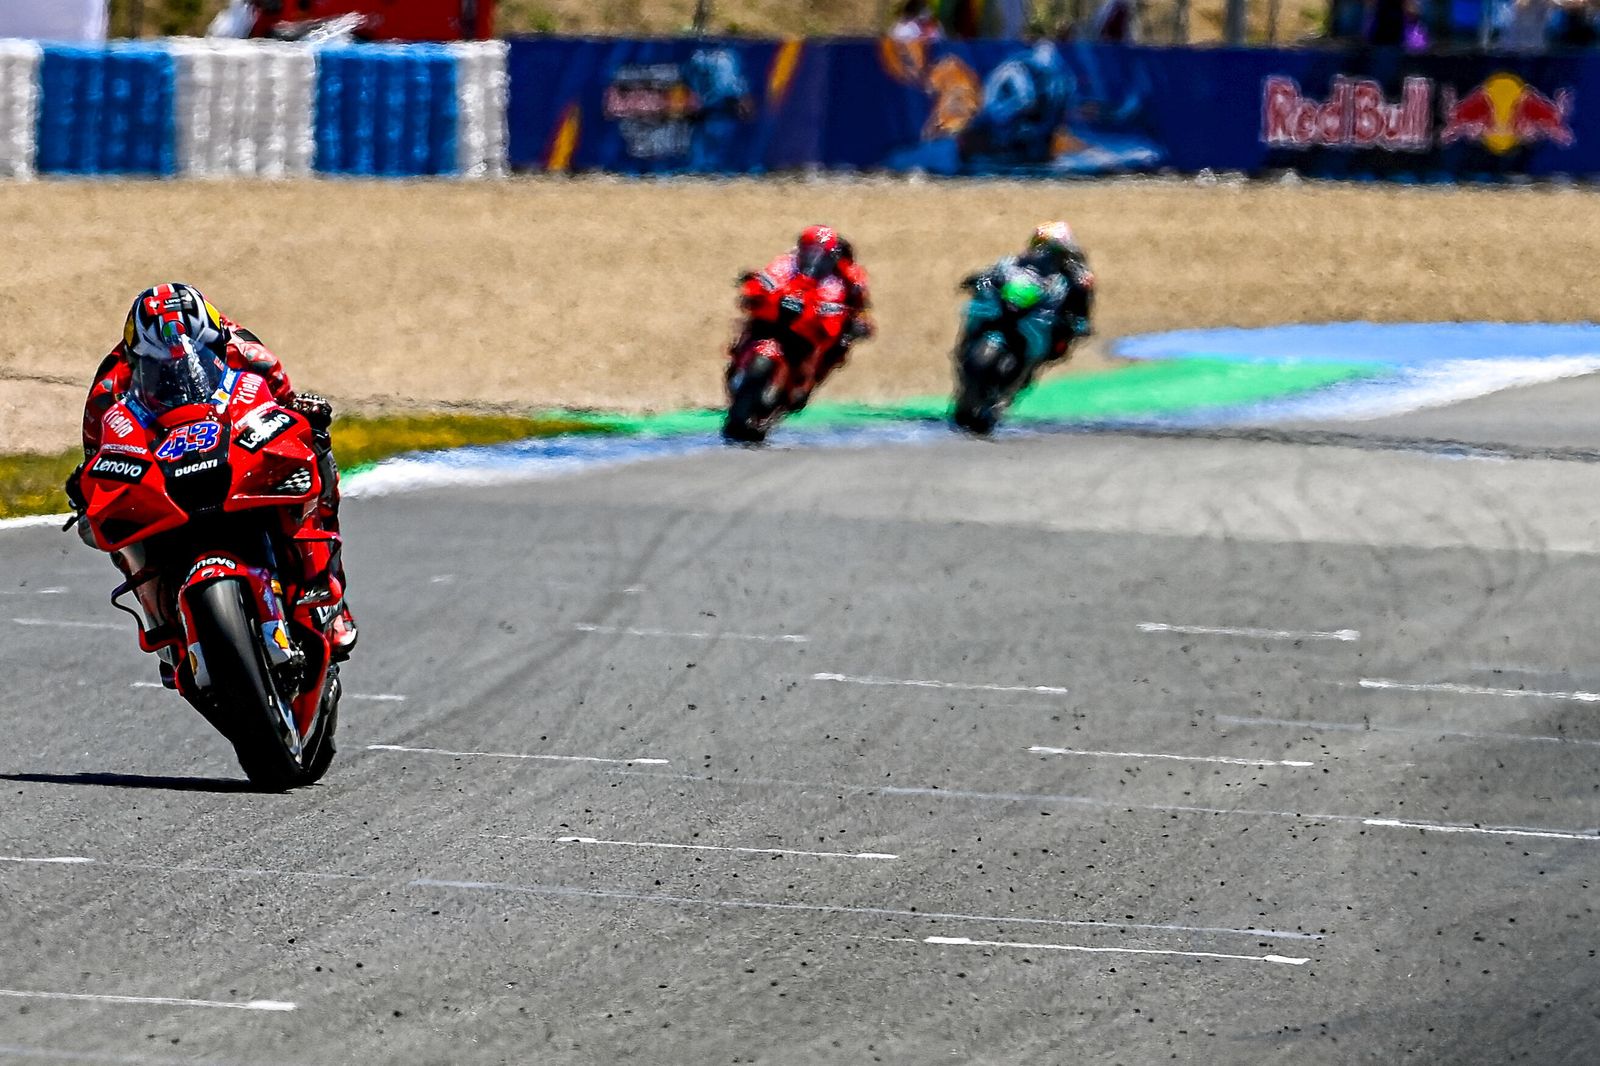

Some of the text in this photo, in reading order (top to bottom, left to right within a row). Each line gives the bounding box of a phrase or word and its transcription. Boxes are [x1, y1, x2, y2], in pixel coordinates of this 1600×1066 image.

[155, 421, 222, 462] 43
[239, 413, 290, 448] Leovo
[92, 457, 142, 477] Lenovo
[174, 459, 218, 477] DUCATI
